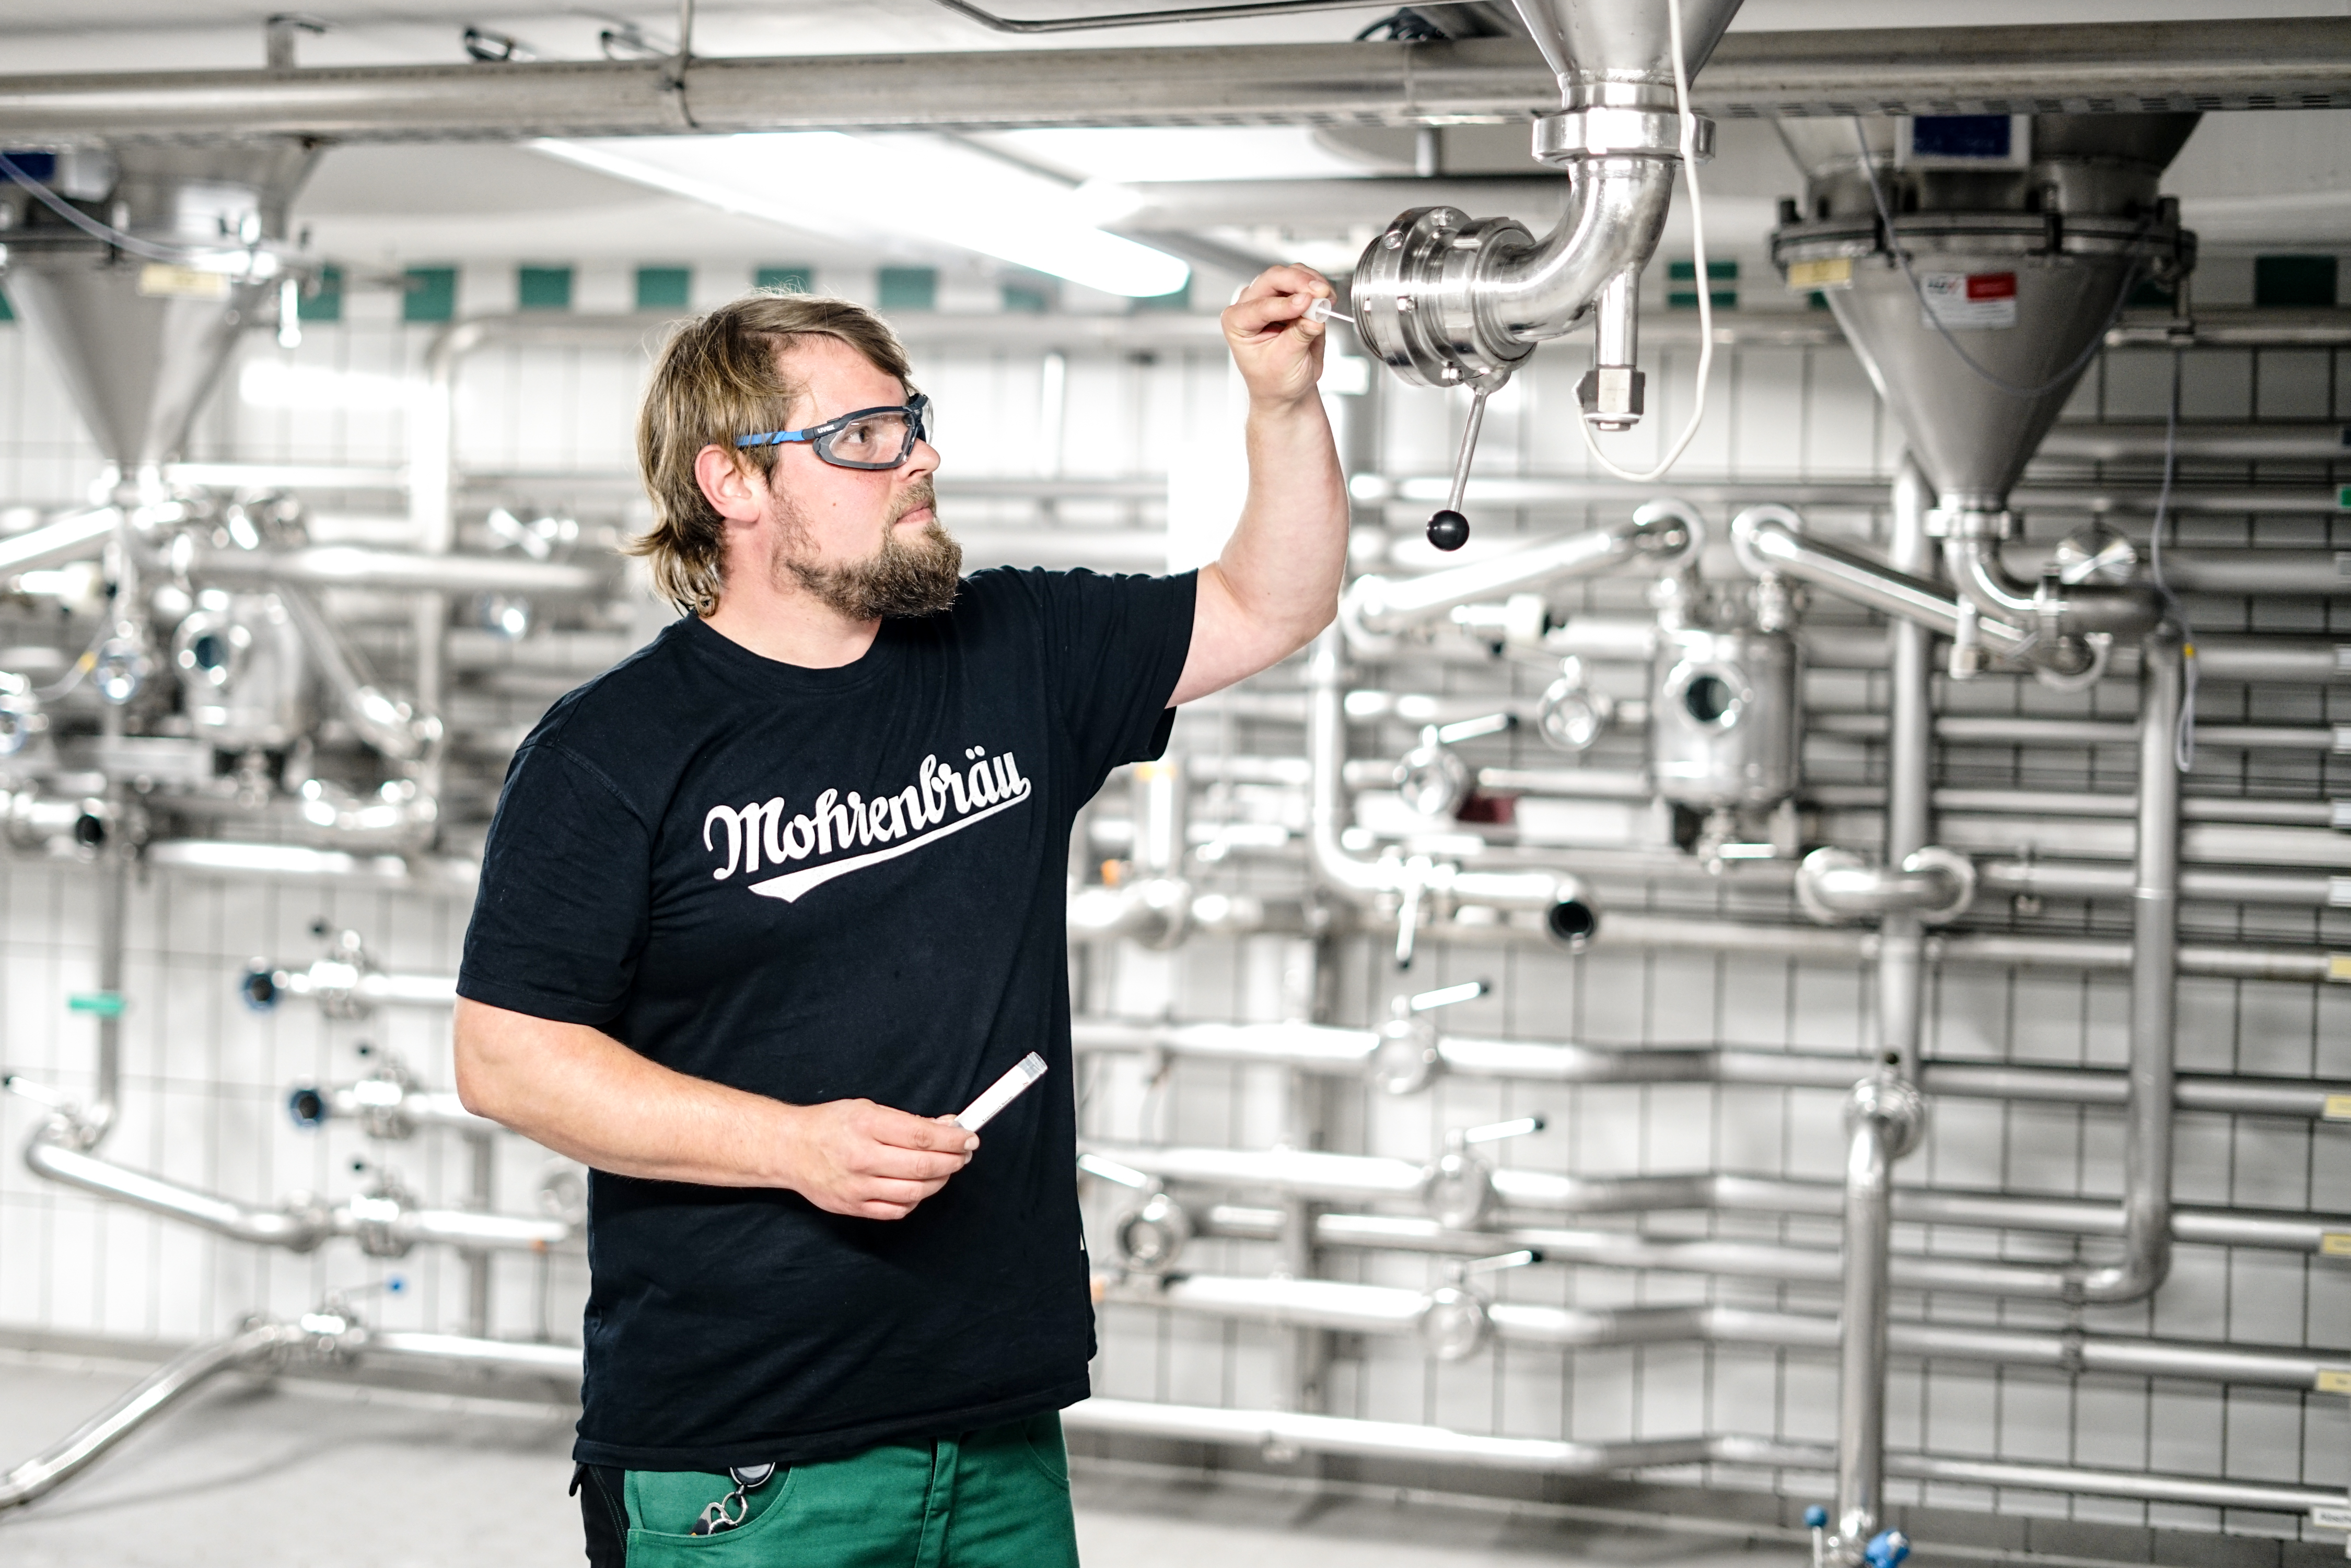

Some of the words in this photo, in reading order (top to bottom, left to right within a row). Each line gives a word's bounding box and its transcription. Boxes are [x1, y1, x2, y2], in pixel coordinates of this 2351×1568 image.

[817, 424, 835, 434] uvex
[703, 745, 1031, 881] Mohrenbräu
[982, 1105, 1002, 1122] Transport
[1001, 1095, 1014, 1106] Swab
